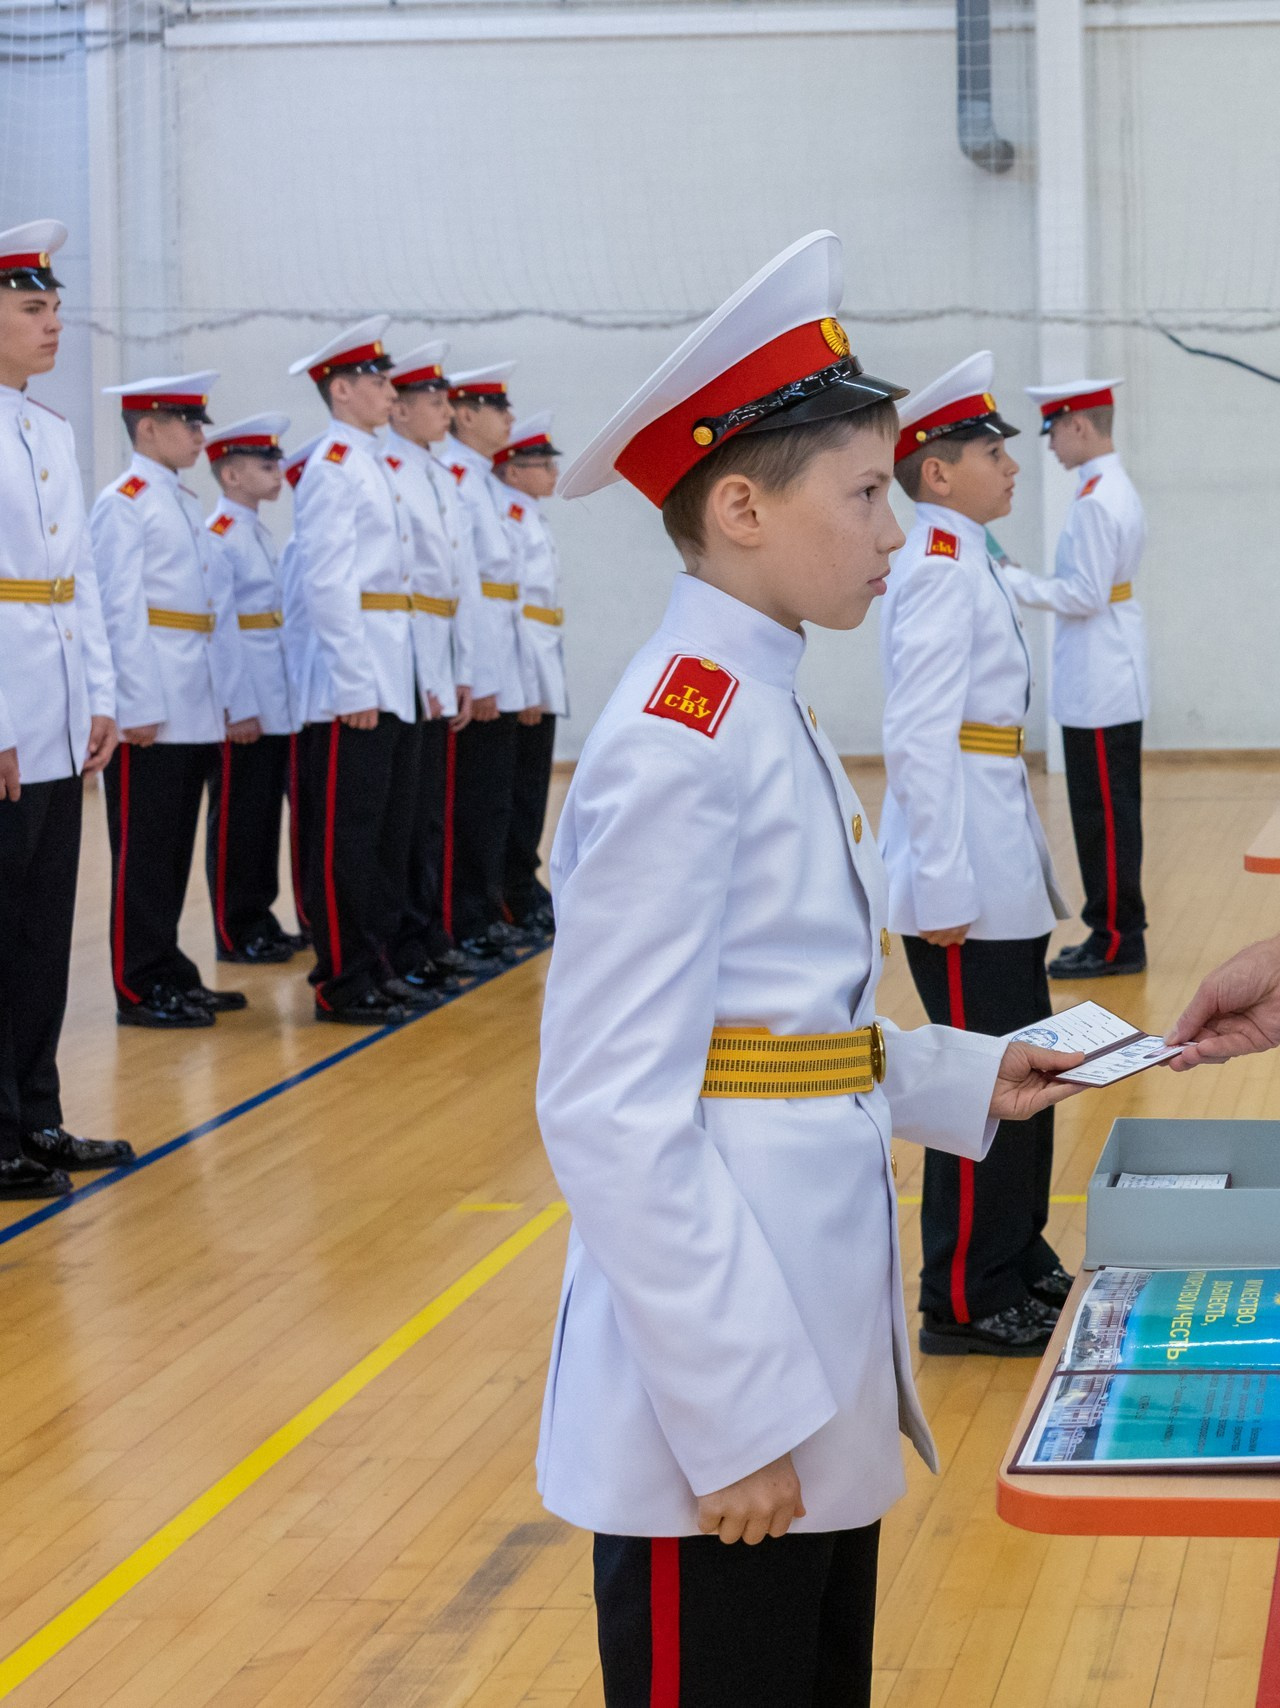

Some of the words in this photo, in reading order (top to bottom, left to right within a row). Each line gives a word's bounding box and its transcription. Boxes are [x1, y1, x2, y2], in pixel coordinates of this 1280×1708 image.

[664, 693, 711, 718] СВУ
[1175, 1303, 1196, 1311] И
[1200, 1280, 1234, 1326] ДОБЛЕСТЬ,
[1232, 1279, 1264, 1327] МУЖЕСТВО,
[1166, 1312, 1194, 1360] ЧЕСТЬ
